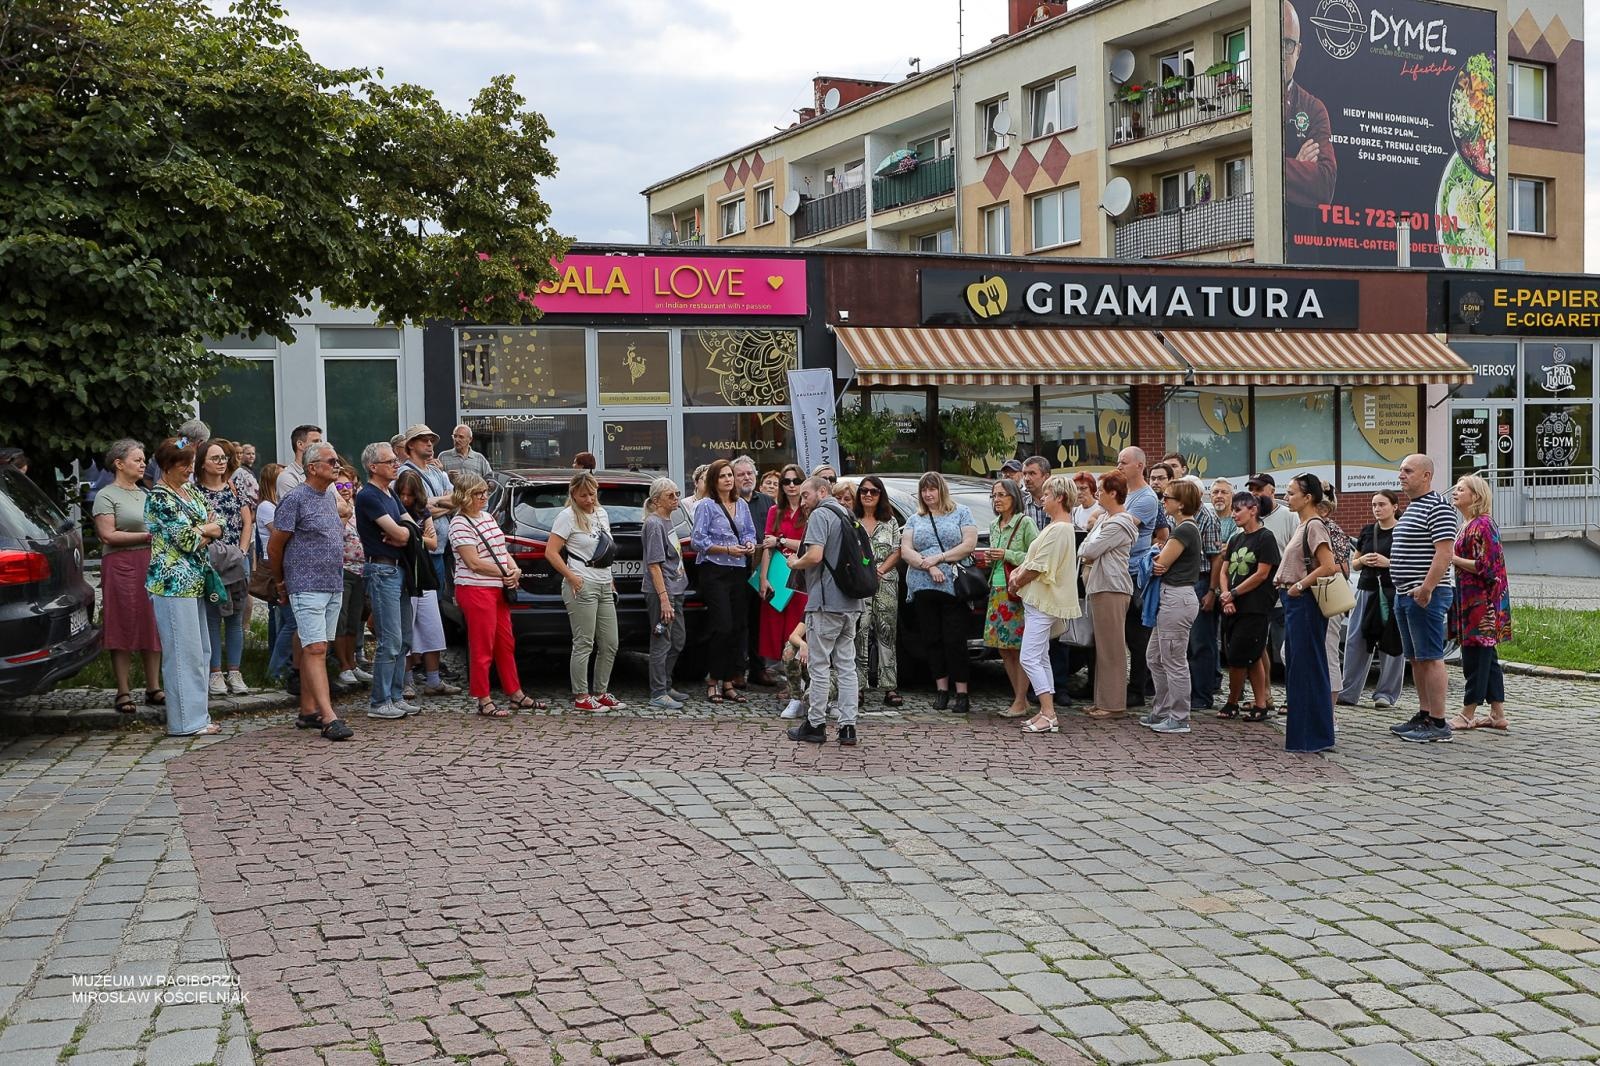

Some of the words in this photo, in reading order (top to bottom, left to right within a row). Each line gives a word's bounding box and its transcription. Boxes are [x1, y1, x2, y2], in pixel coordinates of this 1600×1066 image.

[1369, 9, 1457, 56] DYMEL
[1322, 38, 1356, 57] STUDIO
[1400, 58, 1456, 81] Lifestyle
[1343, 107, 1366, 119] KIEDY
[1367, 110, 1384, 120] INNI
[1360, 123, 1370, 132] TY
[1371, 126, 1393, 136] MASZ
[1328, 134, 1349, 144] JEDZ
[1350, 136, 1384, 149] DOBRZE,
[1384, 140, 1414, 151] TRENUJ
[1358, 149, 1376, 160] ŚPIJ
[1376, 153, 1421, 166] SPOKOJNIE.
[1318, 203, 1361, 226] TEL:
[1365, 208, 1397, 228] 723
[654, 264, 746, 299] LOVE
[665, 301, 688, 310] Indian
[689, 302, 726, 310] restaurant
[1025, 281, 1325, 319] GRAMATURA
[1493, 288, 1600, 308] E-PAPIER
[1463, 304, 1480, 312] E-DYM
[1546, 371, 1572, 389] LIQUID
[1554, 367, 1571, 377] PRA
[1364, 394, 1376, 429] DIETY
[709, 441, 747, 450] MASALA
[750, 440, 775, 449] LOVE
[1543, 436, 1574, 447] E-DYM
